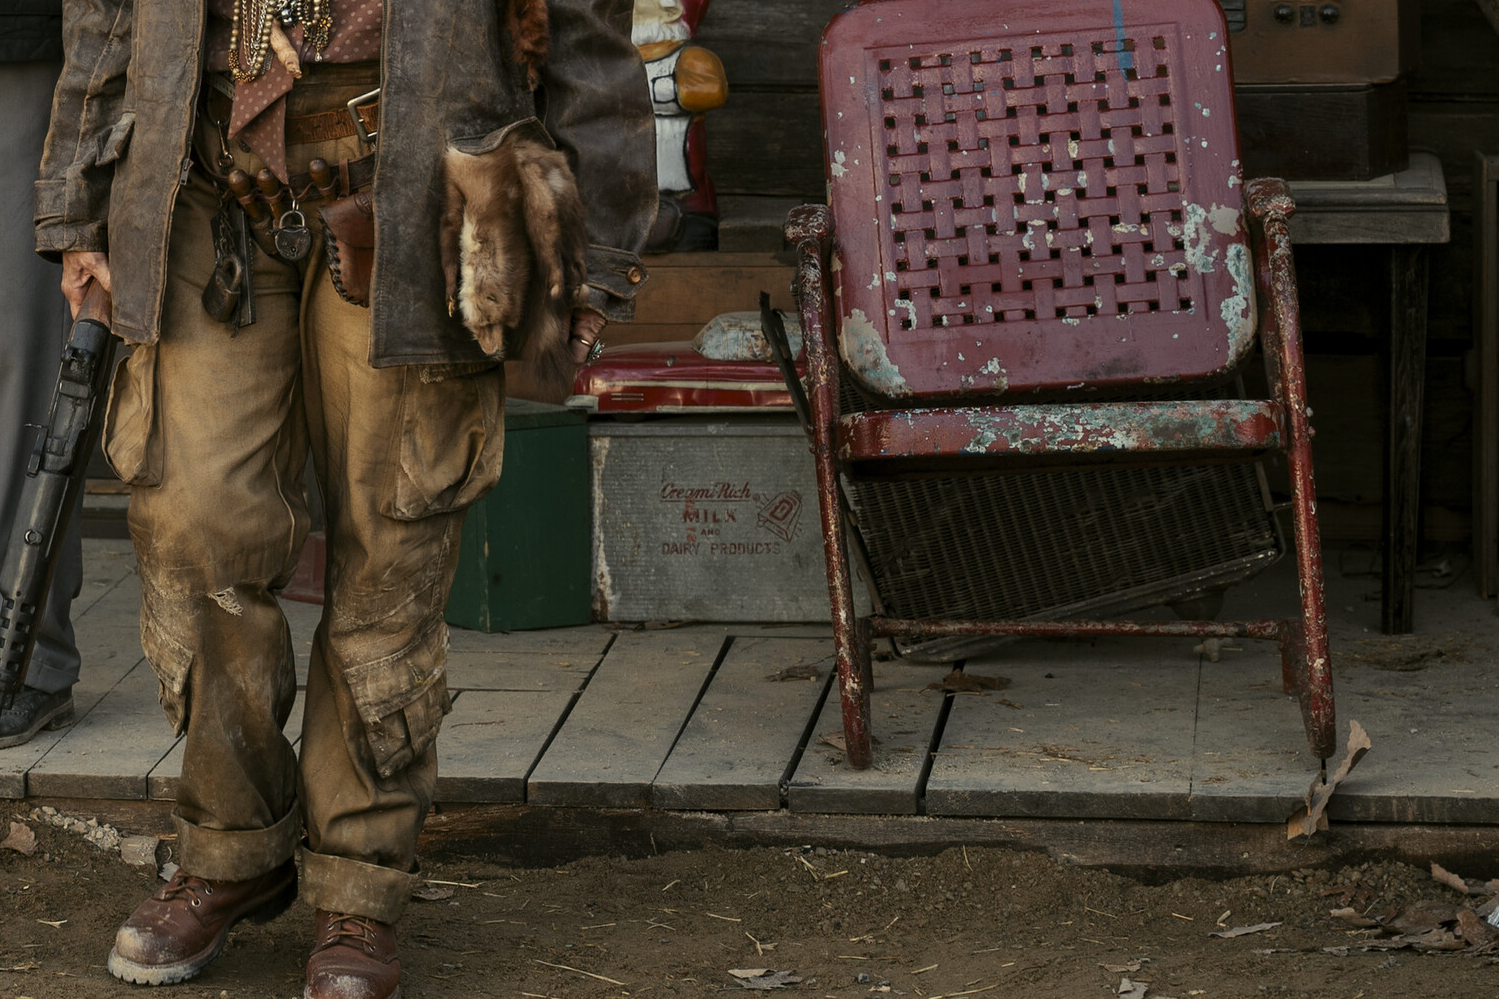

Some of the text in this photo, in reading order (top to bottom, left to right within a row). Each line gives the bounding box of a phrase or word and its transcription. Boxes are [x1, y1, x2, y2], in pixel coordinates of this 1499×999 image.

[682, 508, 737, 523] MILK
[700, 528, 721, 536] AND
[661, 540, 781, 555] DAIRY PRODUCTS
